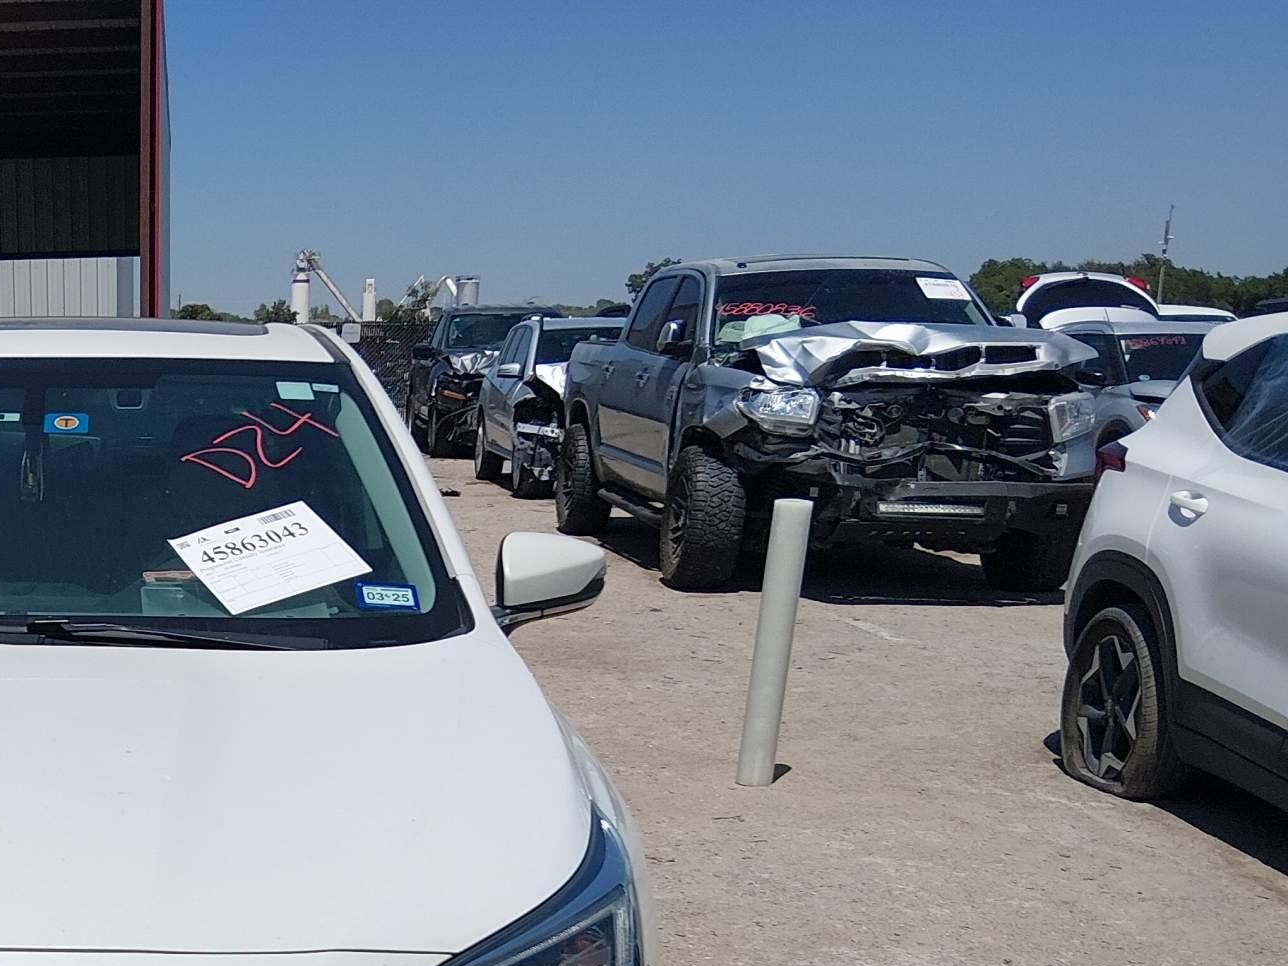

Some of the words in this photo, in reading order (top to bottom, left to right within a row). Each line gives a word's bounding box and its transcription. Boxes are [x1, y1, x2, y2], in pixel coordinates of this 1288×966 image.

[201, 522, 309, 563] 45863043
[367, 592, 385, 601] 03
[392, 593, 410, 603] 25
